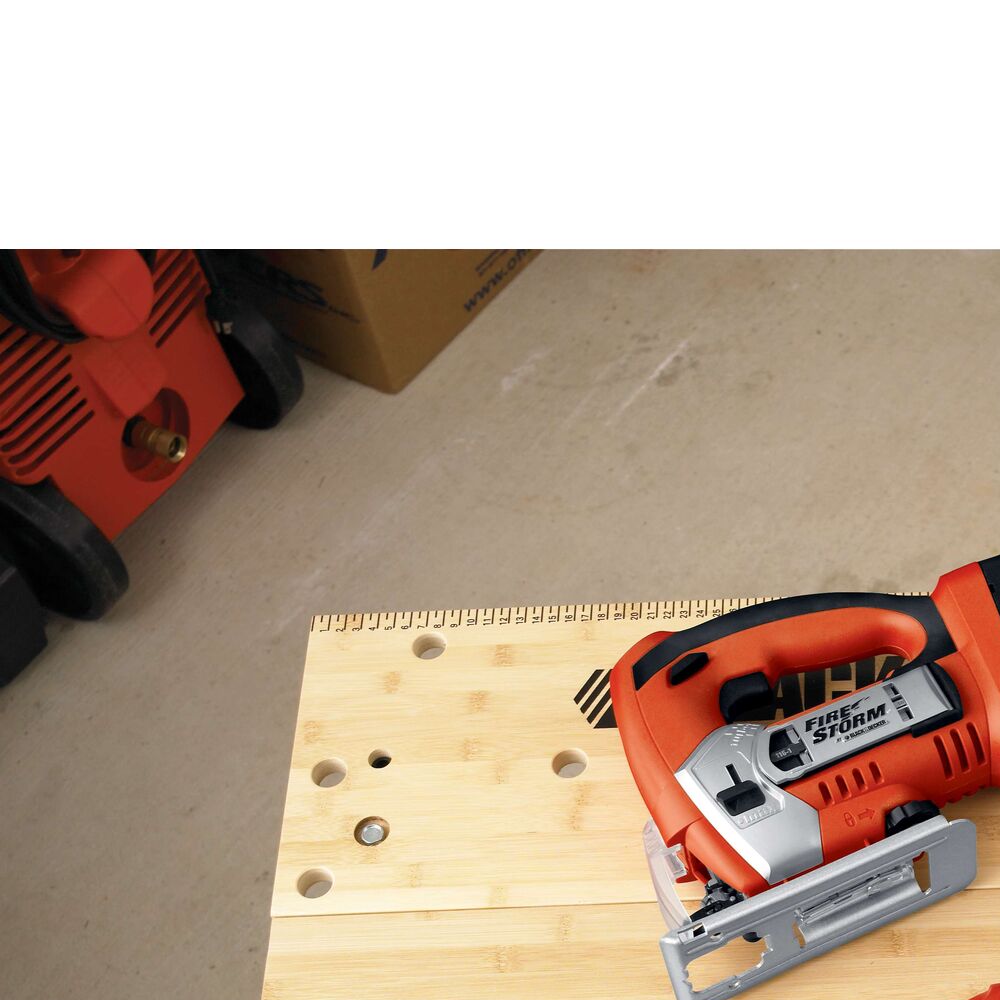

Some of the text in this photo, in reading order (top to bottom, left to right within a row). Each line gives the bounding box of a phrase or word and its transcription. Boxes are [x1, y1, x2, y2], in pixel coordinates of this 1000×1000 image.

[467, 618, 475, 626] 10
[549, 615, 557, 623] 15
[597, 613, 606, 621] 18
[630, 611, 639, 620] 20
[696, 609, 705, 618] 24
[804, 703, 853, 734] FIRE
[812, 703, 887, 745] STORM
